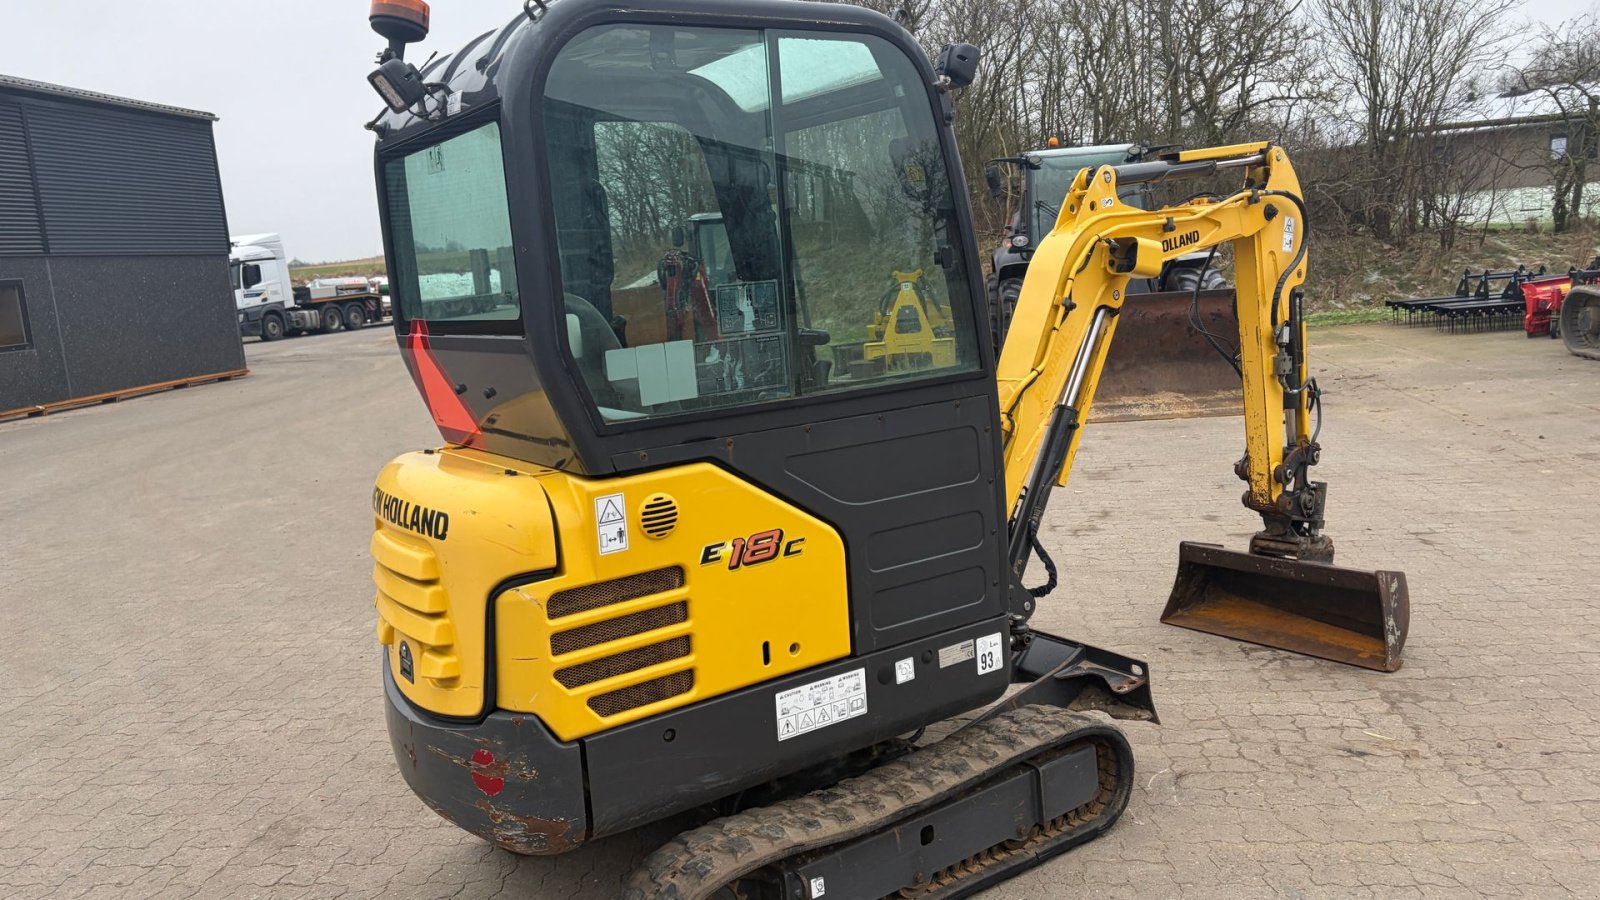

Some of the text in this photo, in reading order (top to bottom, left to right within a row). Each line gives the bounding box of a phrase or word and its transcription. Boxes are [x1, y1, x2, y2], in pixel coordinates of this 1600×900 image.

[1162, 231, 1199, 252] OLLAND
[373, 488, 449, 540] EW HOLLAND
[981, 651, 993, 670] 93
